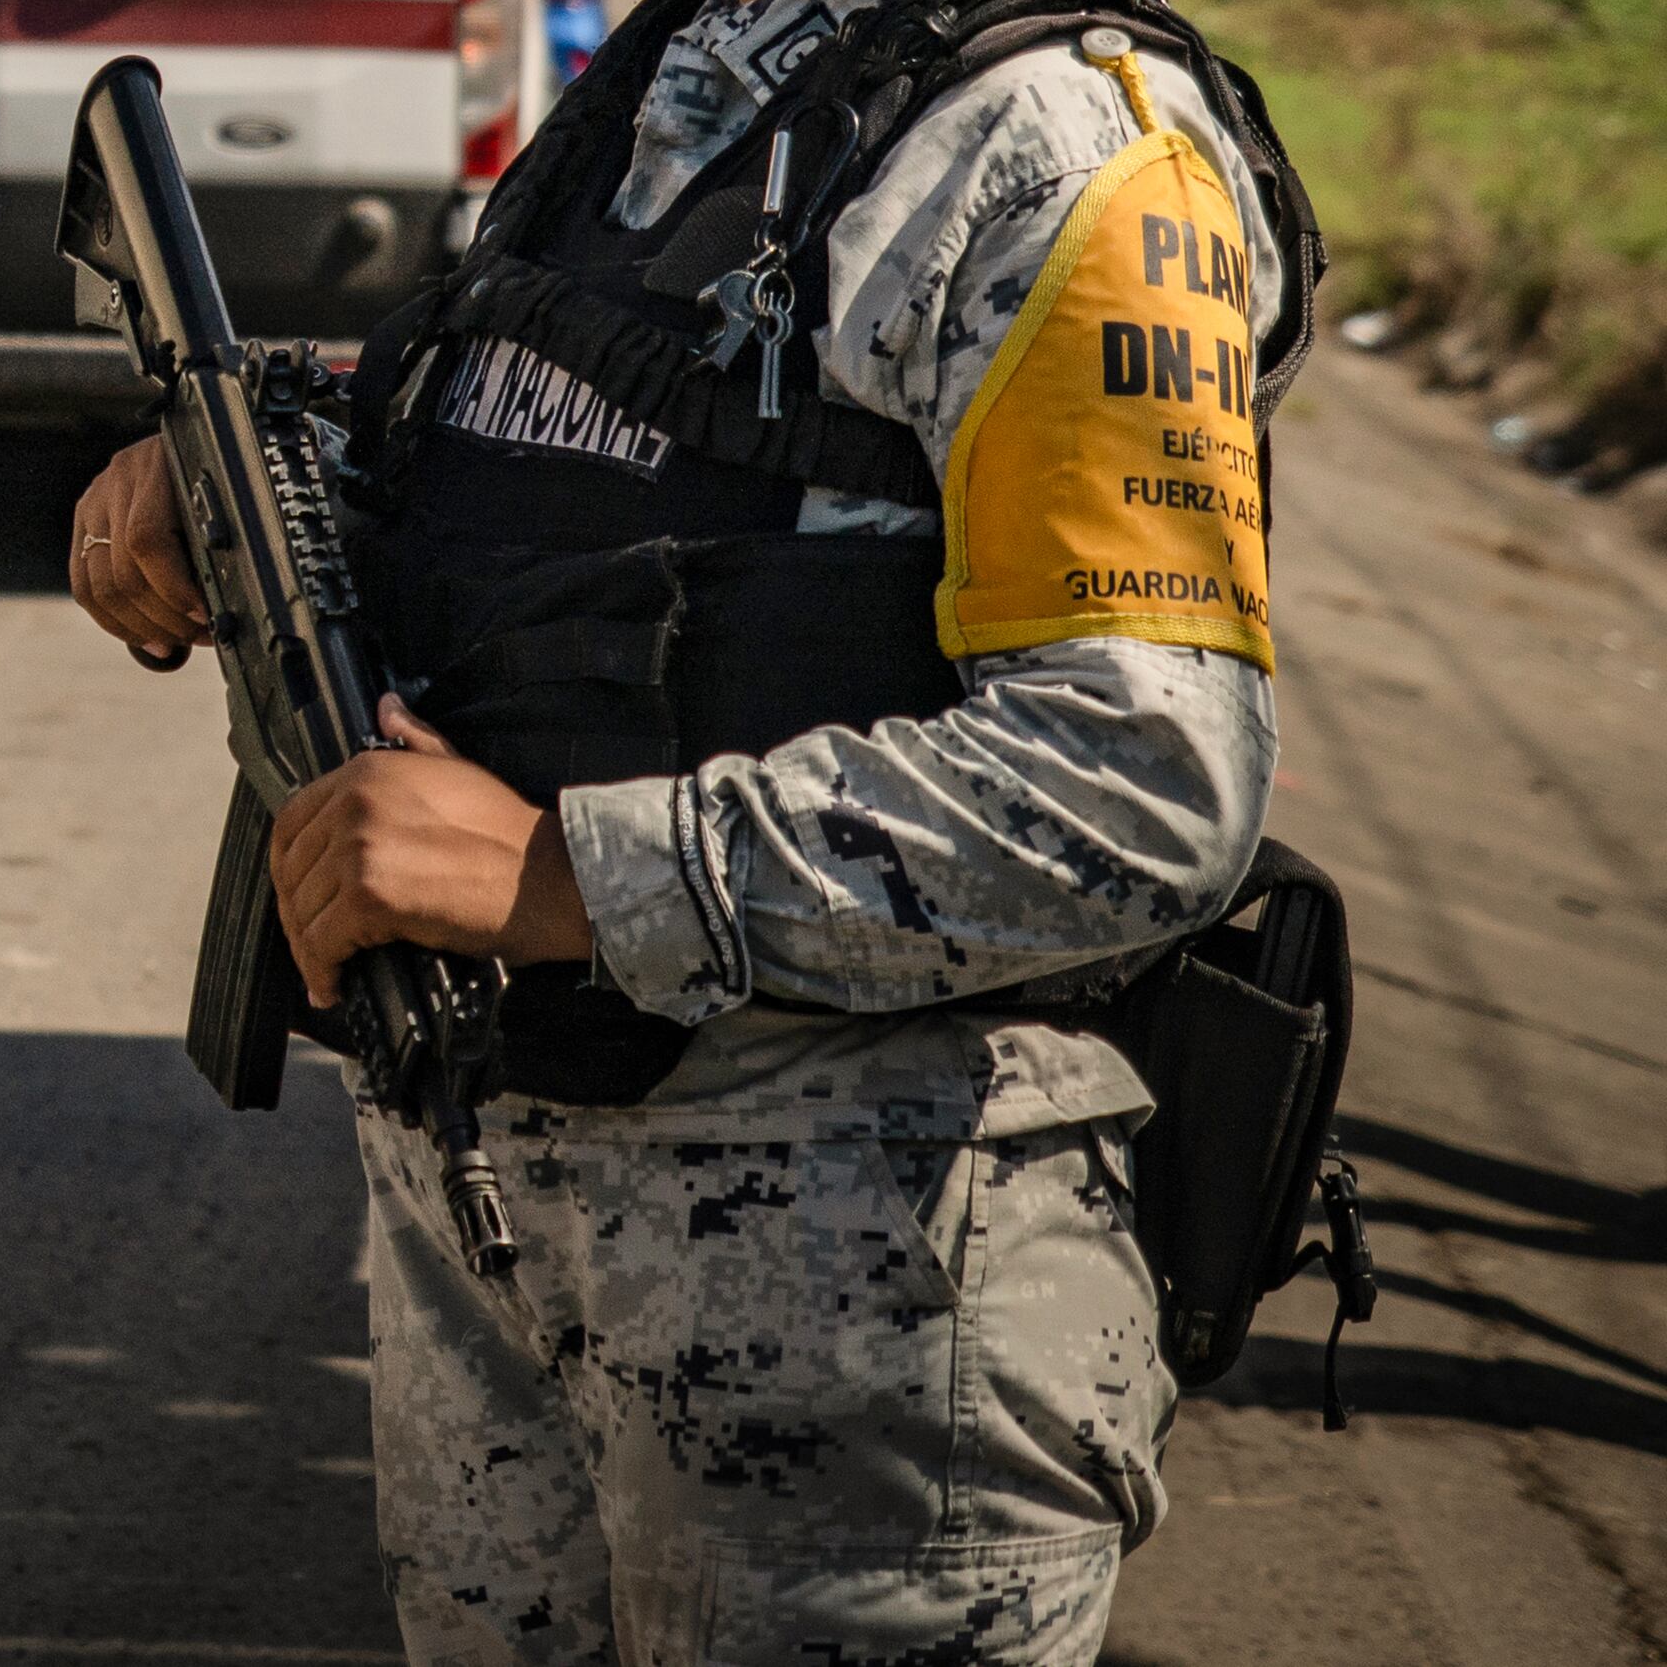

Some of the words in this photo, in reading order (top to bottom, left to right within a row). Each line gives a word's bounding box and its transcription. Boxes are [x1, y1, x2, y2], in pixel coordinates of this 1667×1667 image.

[1142, 213, 1247, 323] PLAN
[1163, 426, 1257, 482] EJÉCITO
[1124, 477, 1229, 518] FUERZA
[1224, 537, 1235, 566] Y
[1065, 569, 1223, 604] GUARDIA
